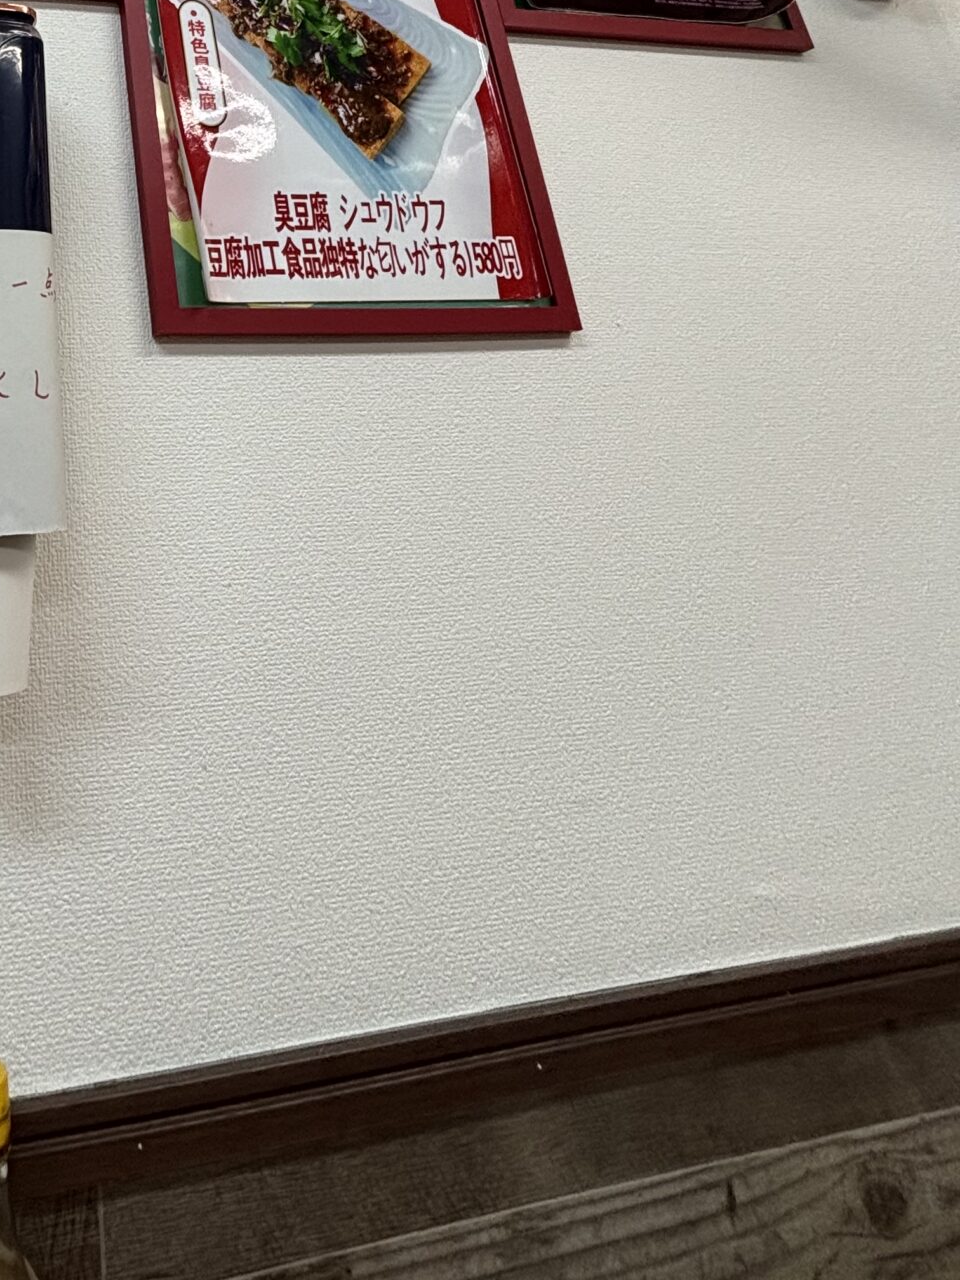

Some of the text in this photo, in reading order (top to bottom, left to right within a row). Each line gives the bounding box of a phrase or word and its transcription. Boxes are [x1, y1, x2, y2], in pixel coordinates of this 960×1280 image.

[273, 190, 446, 233] 臭豆腐 シュウドウフ
